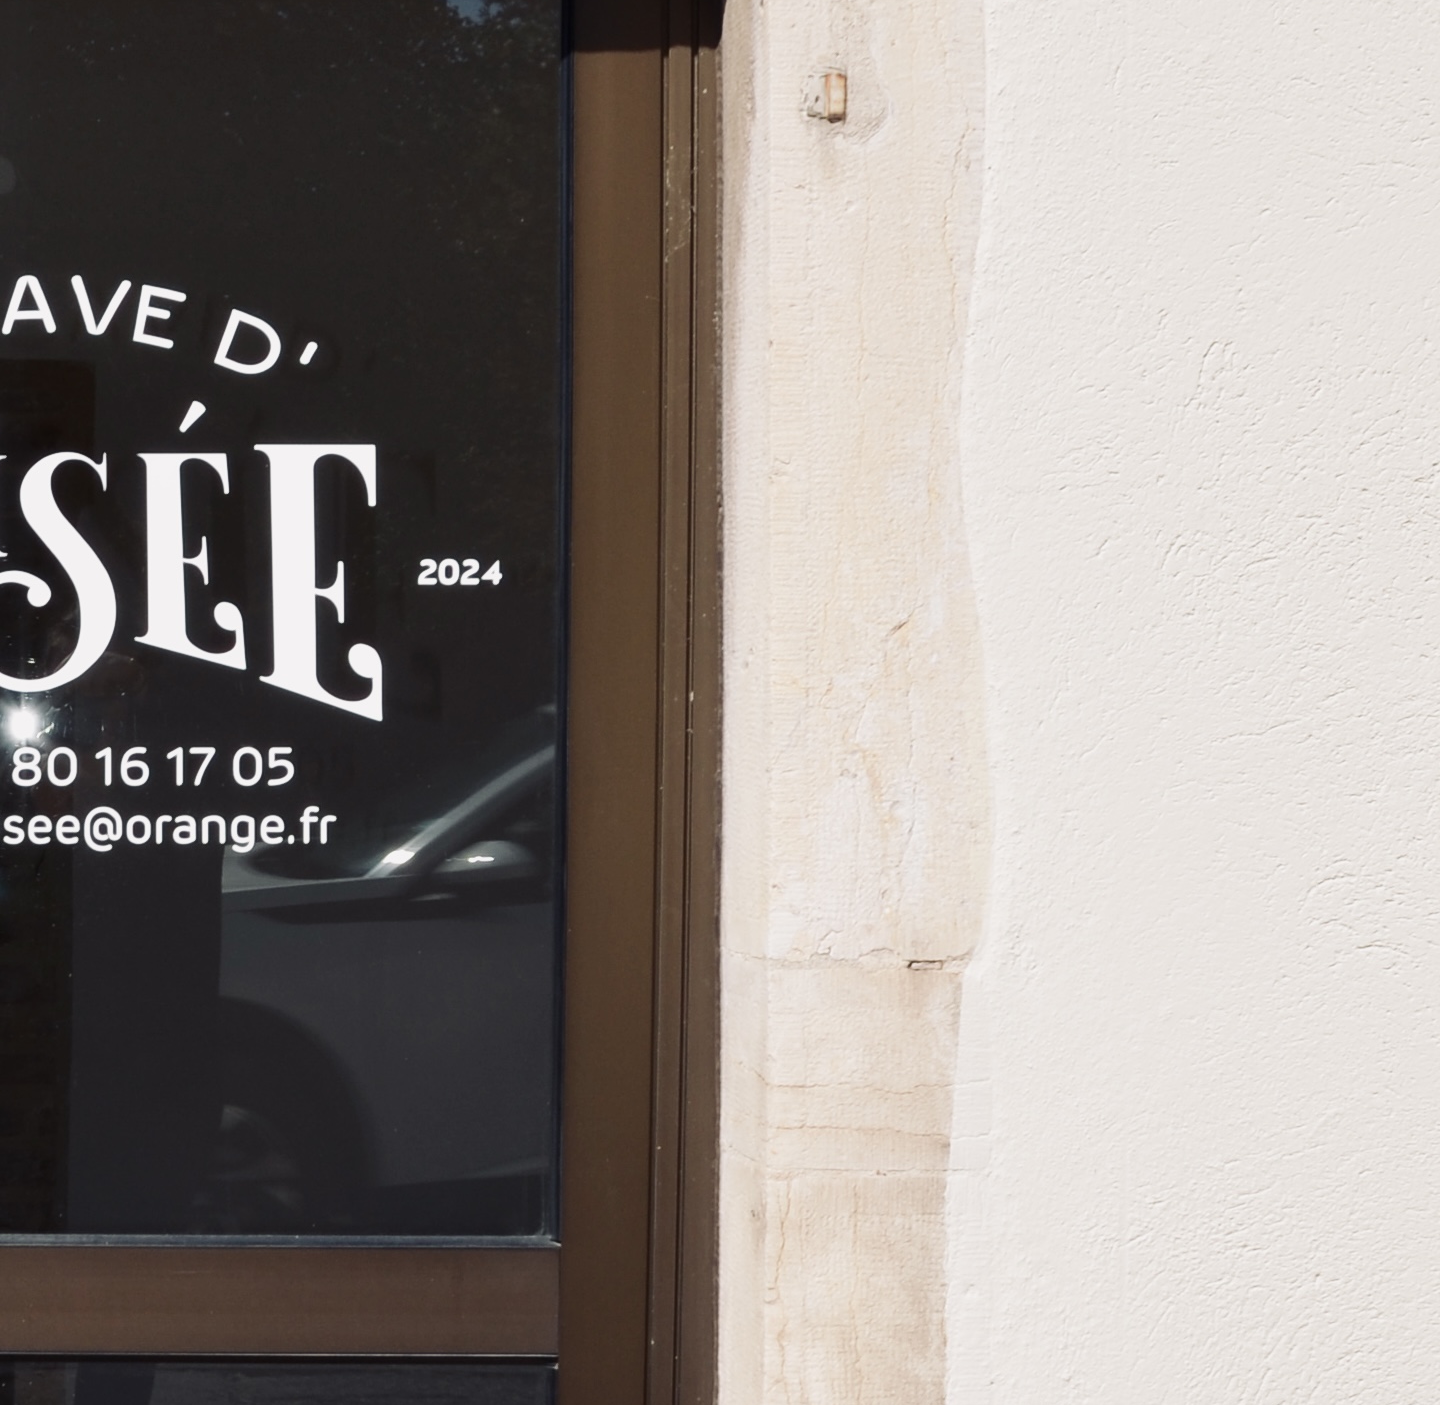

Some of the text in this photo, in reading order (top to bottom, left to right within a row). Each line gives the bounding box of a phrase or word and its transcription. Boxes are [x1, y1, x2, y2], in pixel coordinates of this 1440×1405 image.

[417, 558, 503, 586] 2024
[11, 746, 78, 787] 80
[95, 746, 150, 787] 16
[166, 746, 216, 787] 17
[232, 746, 295, 787] 05
